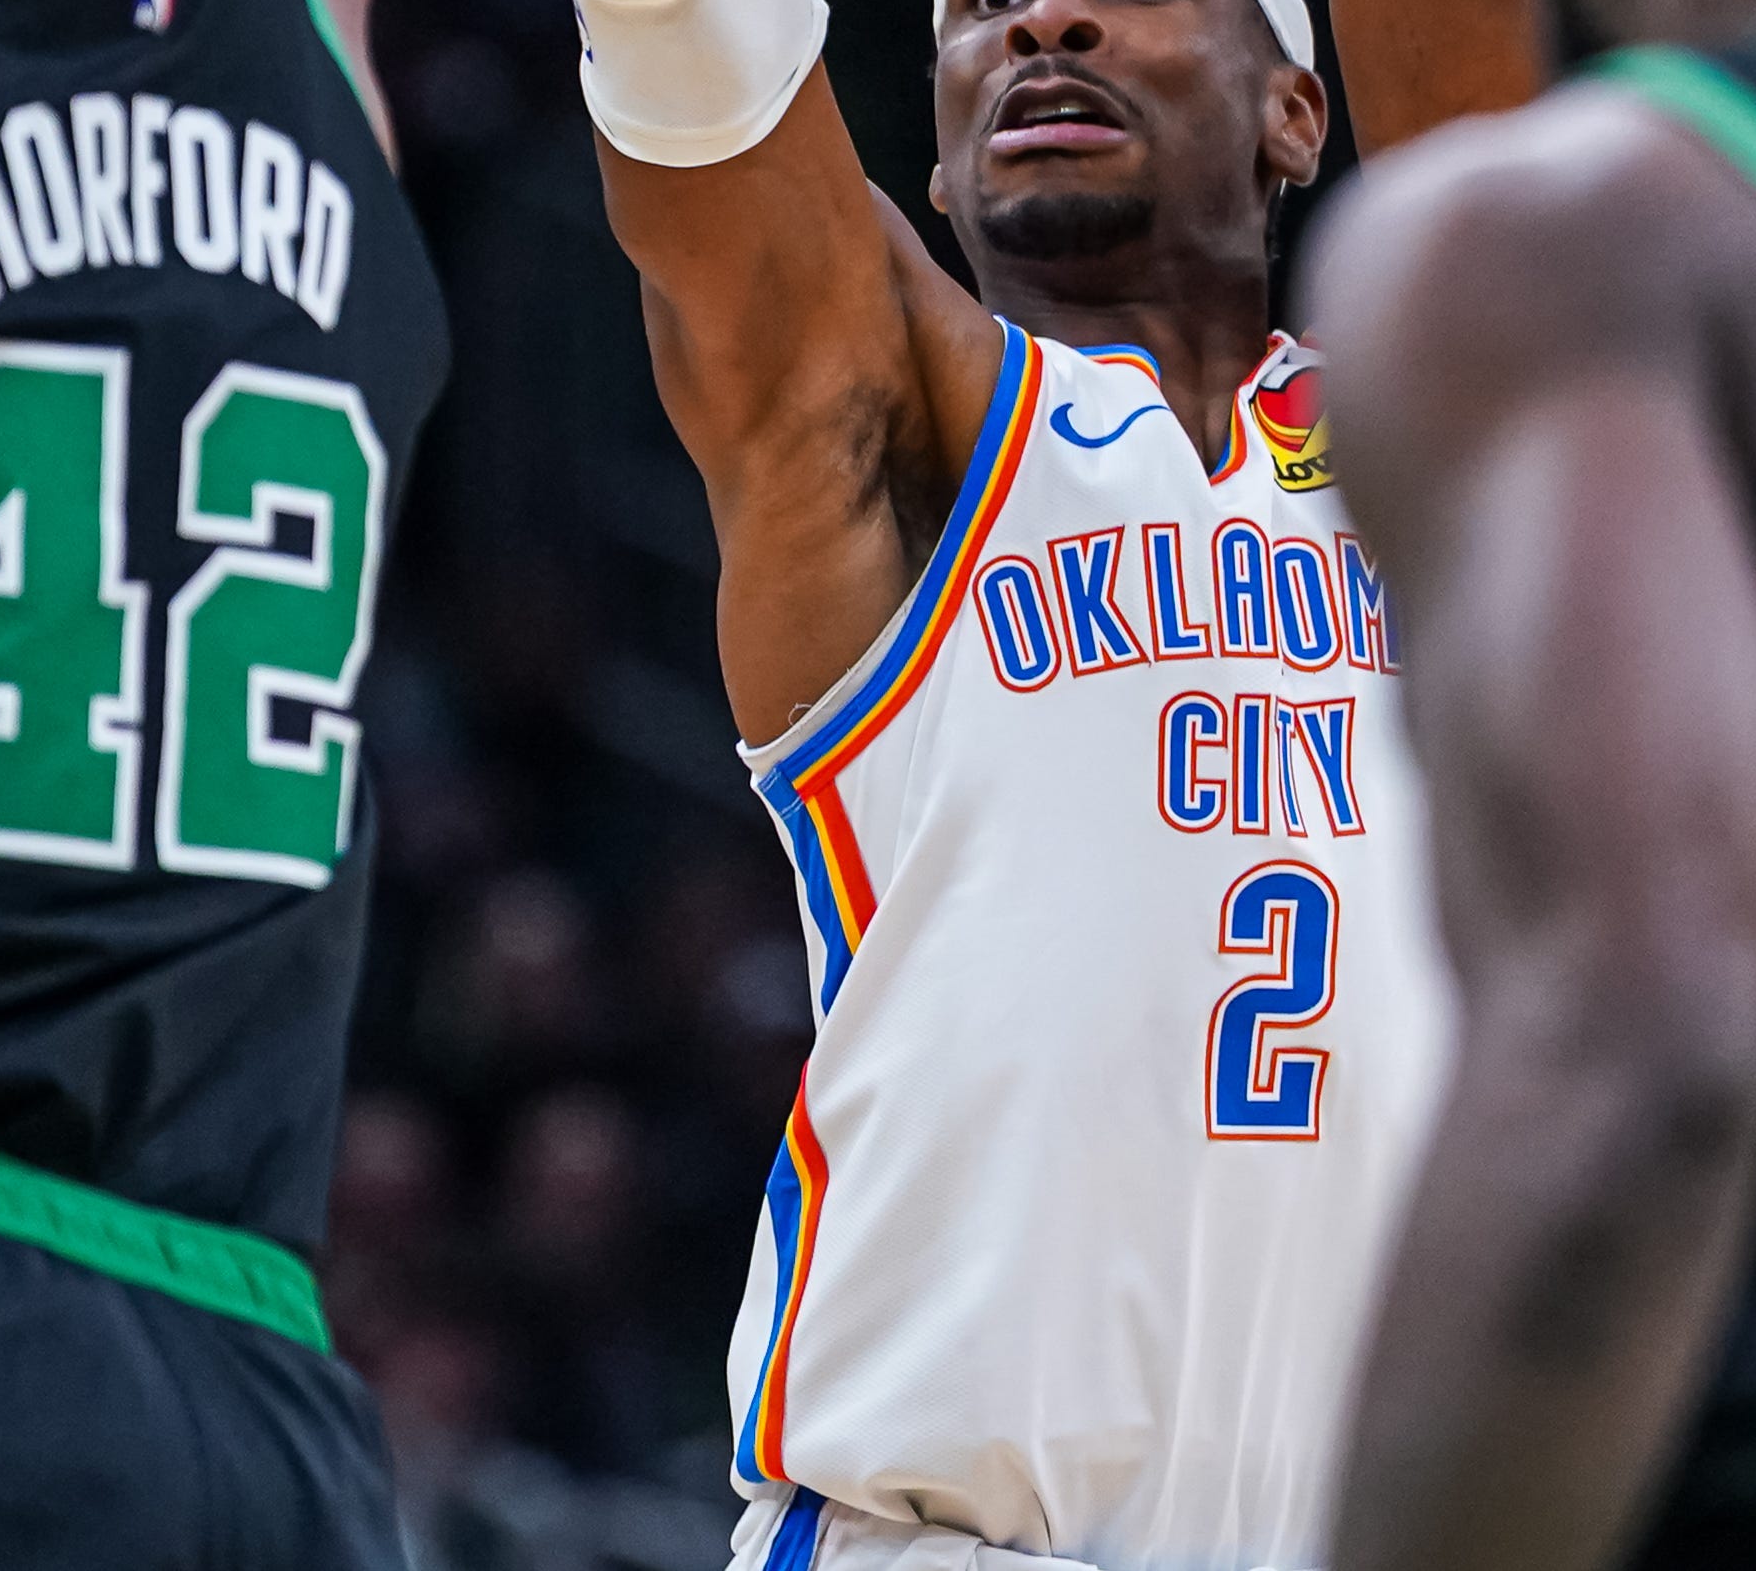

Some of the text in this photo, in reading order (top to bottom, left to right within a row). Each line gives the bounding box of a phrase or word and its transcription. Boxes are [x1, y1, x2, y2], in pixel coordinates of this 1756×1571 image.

[972, 517, 1402, 693] OKLAOM
[1157, 690, 1367, 838] CITY
[1205, 859, 1341, 1141] 2
